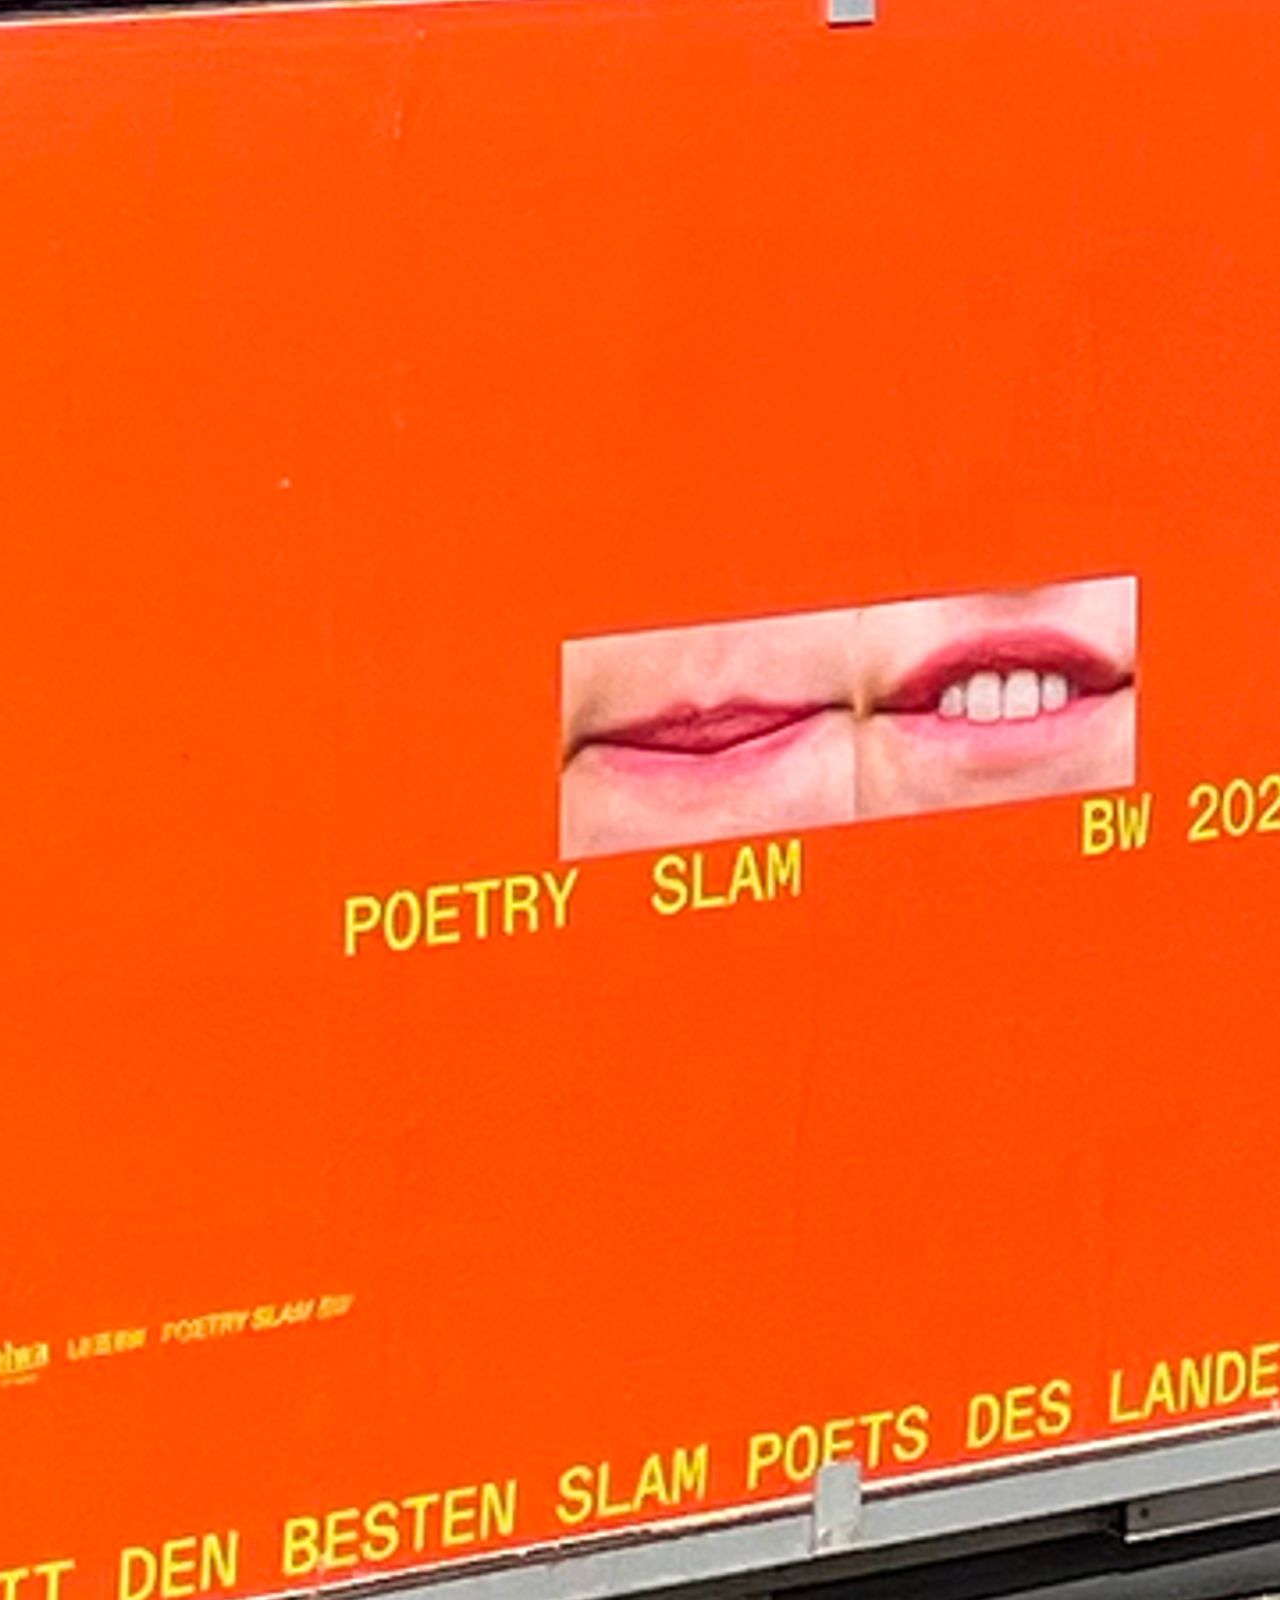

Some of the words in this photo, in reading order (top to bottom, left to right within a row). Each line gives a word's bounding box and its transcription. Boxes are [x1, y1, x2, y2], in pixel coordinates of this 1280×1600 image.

[344, 868, 579, 956] POETRY
[651, 839, 803, 915] SLAM
[1081, 794, 1151, 856] BW
[160, 1310, 250, 1343] POETRY
[250, 1299, 315, 1331] SLAM
[281, 1479, 518, 1577] BESTEN
[555, 1443, 708, 1524] SLAM
[746, 1404, 930, 1490] POETS
[966, 1379, 1072, 1450] DES
